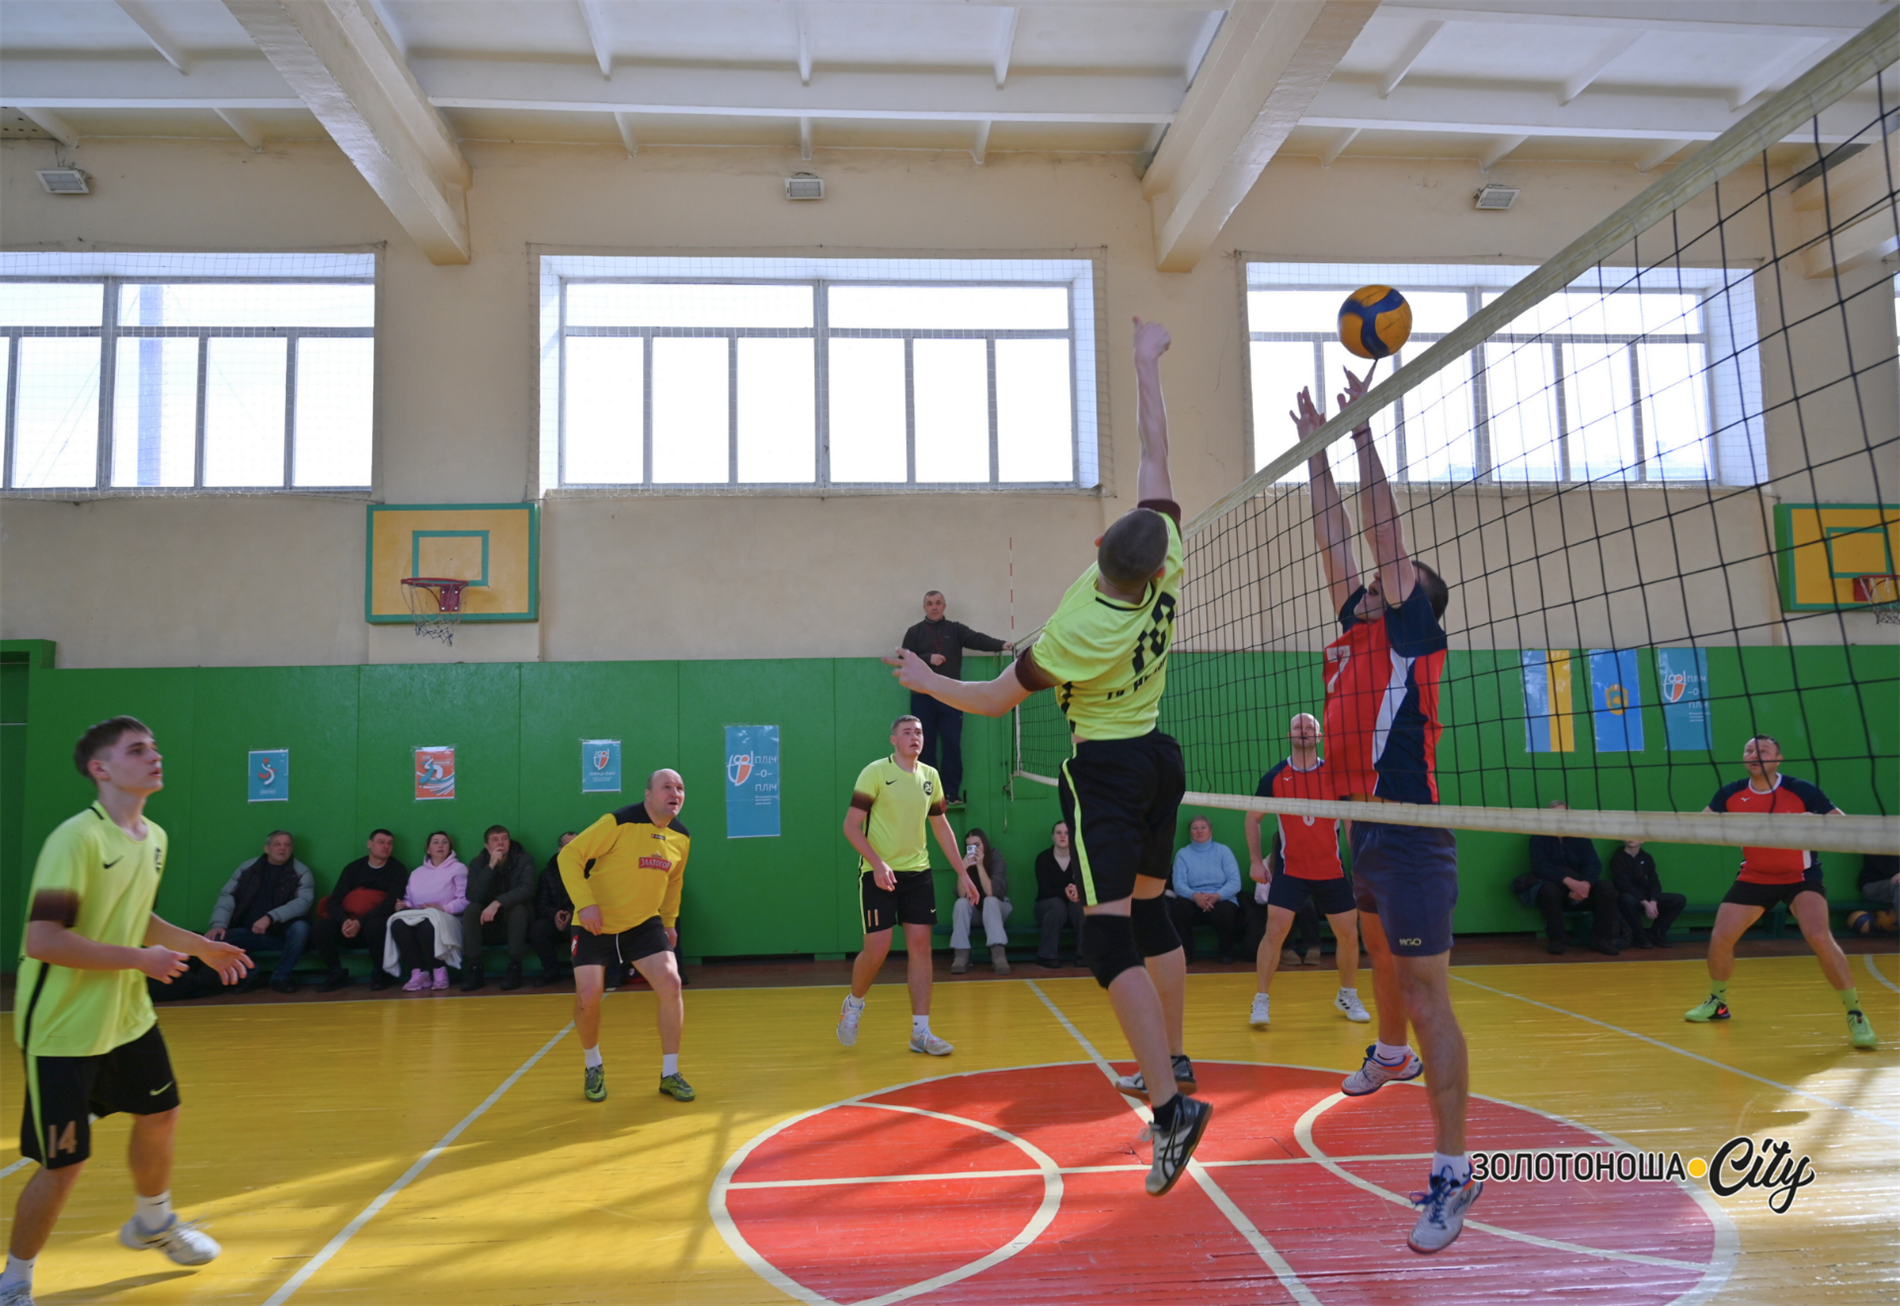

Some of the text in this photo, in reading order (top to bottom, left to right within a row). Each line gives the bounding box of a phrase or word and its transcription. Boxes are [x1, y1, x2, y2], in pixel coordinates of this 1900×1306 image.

[1326, 645, 1351, 693] 7
[1687, 675, 1706, 683] ПЛЧ
[1688, 701, 1708, 709] ПЛЧ
[755, 783, 778, 792] ПЛІЧ
[867, 909, 879, 928] 11
[48, 1121, 78, 1158] 14
